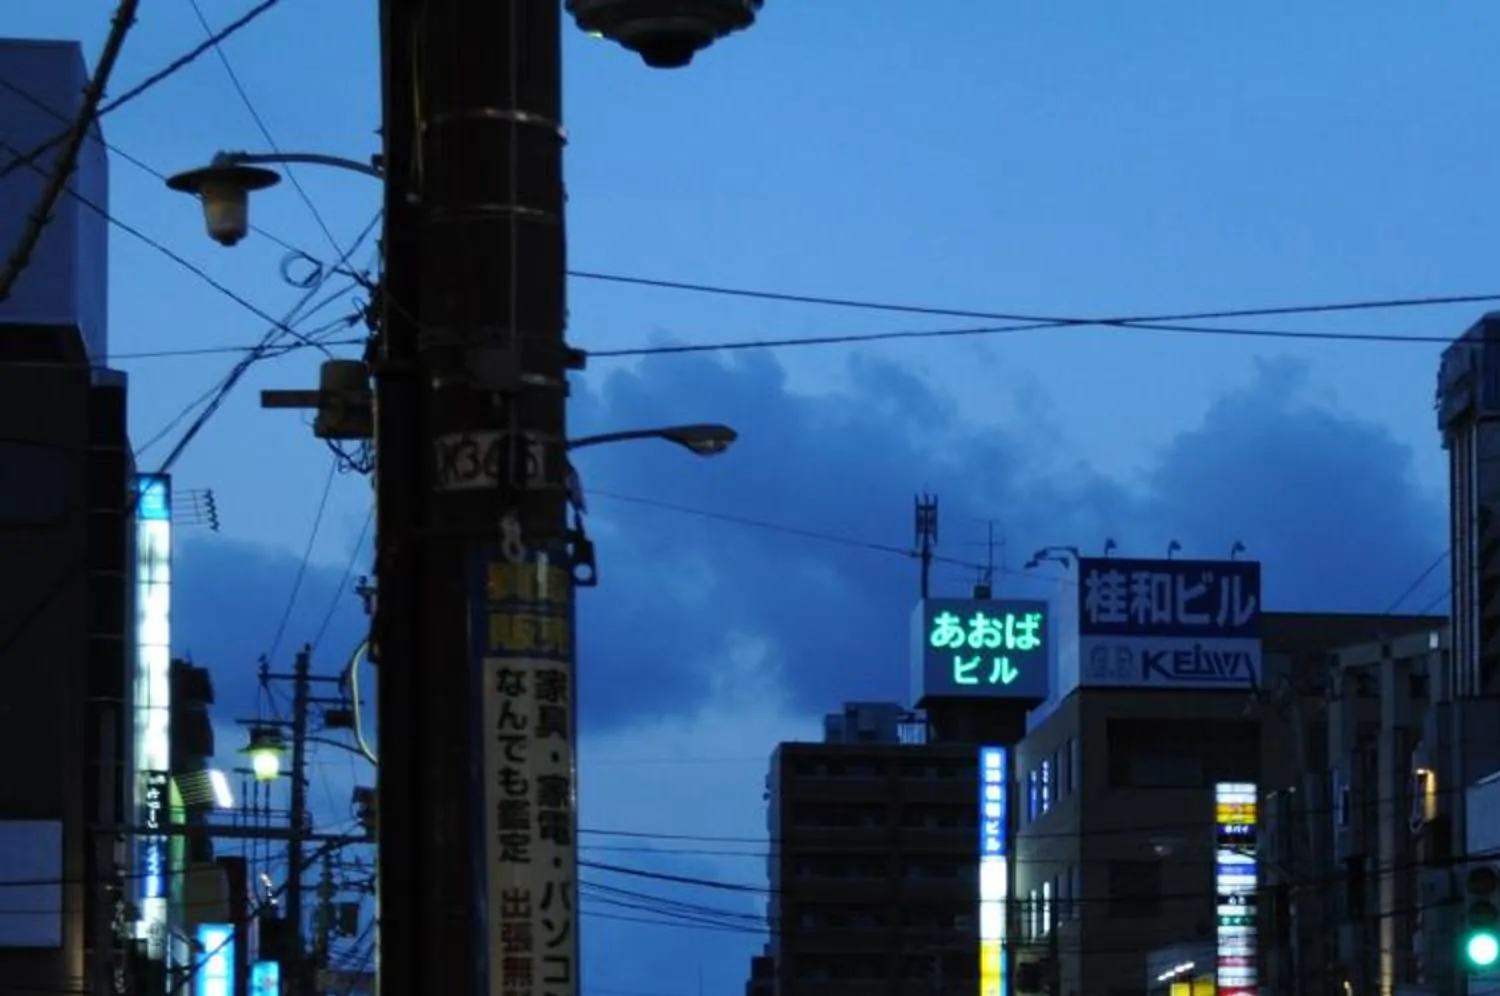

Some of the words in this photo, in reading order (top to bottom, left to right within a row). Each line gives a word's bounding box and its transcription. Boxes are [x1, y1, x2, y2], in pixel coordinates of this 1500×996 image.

[1085, 568, 1257, 629] 桂和ビル
[930, 611, 1042, 651] あおば
[953, 655, 1019, 685] ビル
